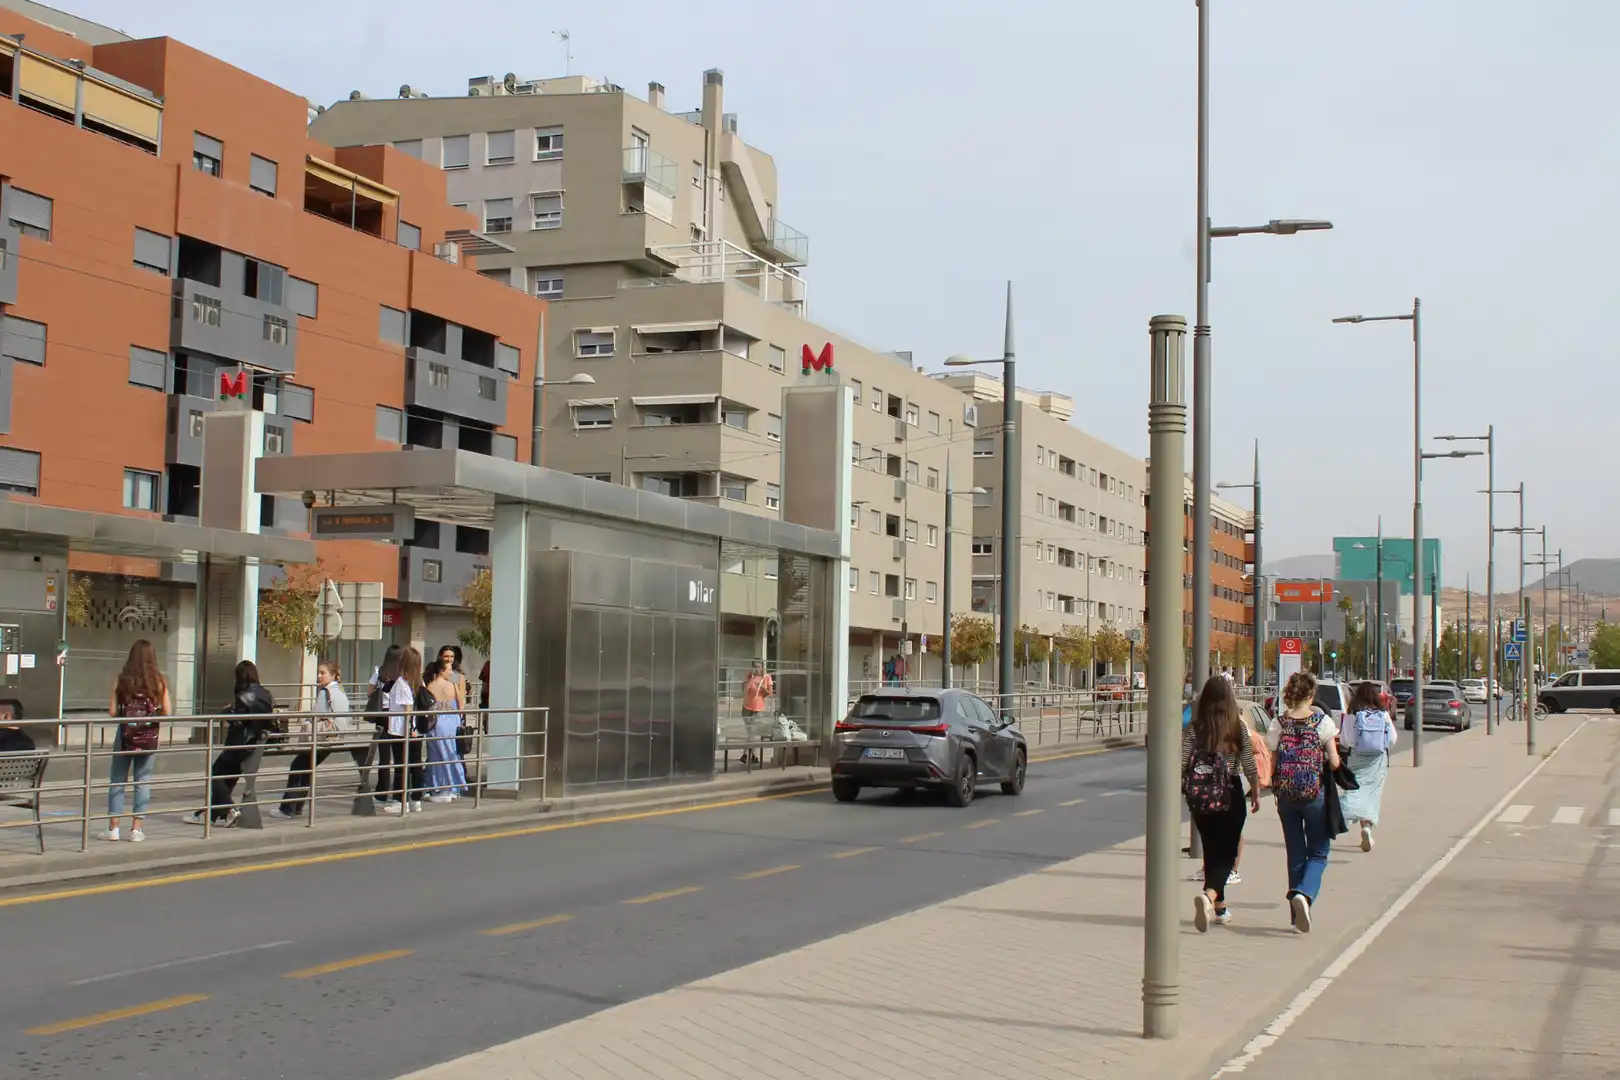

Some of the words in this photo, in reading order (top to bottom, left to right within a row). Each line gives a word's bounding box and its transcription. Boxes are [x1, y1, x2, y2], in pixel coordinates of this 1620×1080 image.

[802, 342, 834, 373] M
[220, 371, 247, 398] M
[689, 580, 714, 603] Dílar
